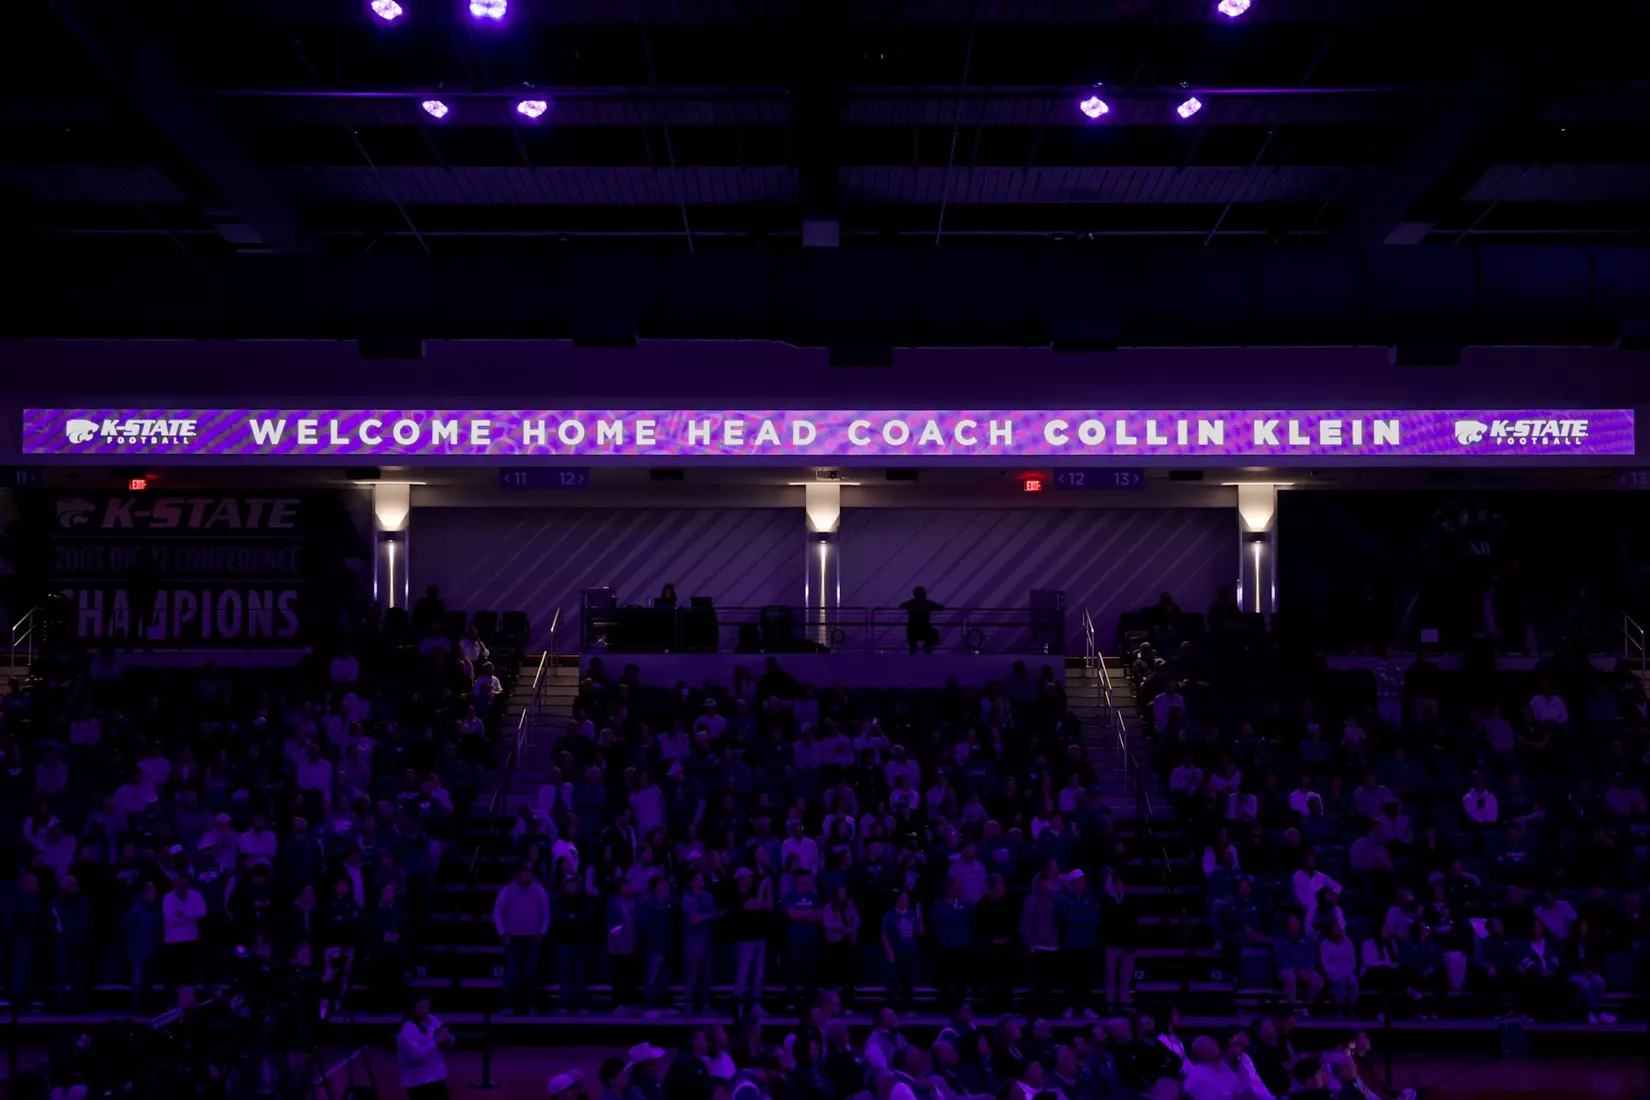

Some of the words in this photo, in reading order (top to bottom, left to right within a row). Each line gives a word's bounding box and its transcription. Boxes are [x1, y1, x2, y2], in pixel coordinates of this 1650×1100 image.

[100, 419, 197, 436] K-STATE
[249, 419, 491, 445] WELCOME
[523, 419, 656, 445] HOME
[688, 420, 817, 446] HEAD
[847, 419, 1012, 446] COACH
[1044, 419, 1224, 446] COLLIN
[1254, 419, 1401, 445] KLEIN
[1489, 419, 1589, 437] K-STATE
[106, 436, 190, 444] FOOTBALL
[1496, 437, 1582, 445] FOOTBALL
[132, 479, 145, 490] EXIT
[514, 471, 527, 486] 11
[559, 471, 576, 486] 12
[1026, 480, 1040, 491] EXIT
[1068, 471, 1085, 486] 12
[1113, 471, 1130, 486] 13
[101, 498, 301, 529] K-STATE
[54, 546, 105, 572] 2003
[173, 546, 302, 572] CONFERENCE
[60, 589, 299, 639] HAPIONS
